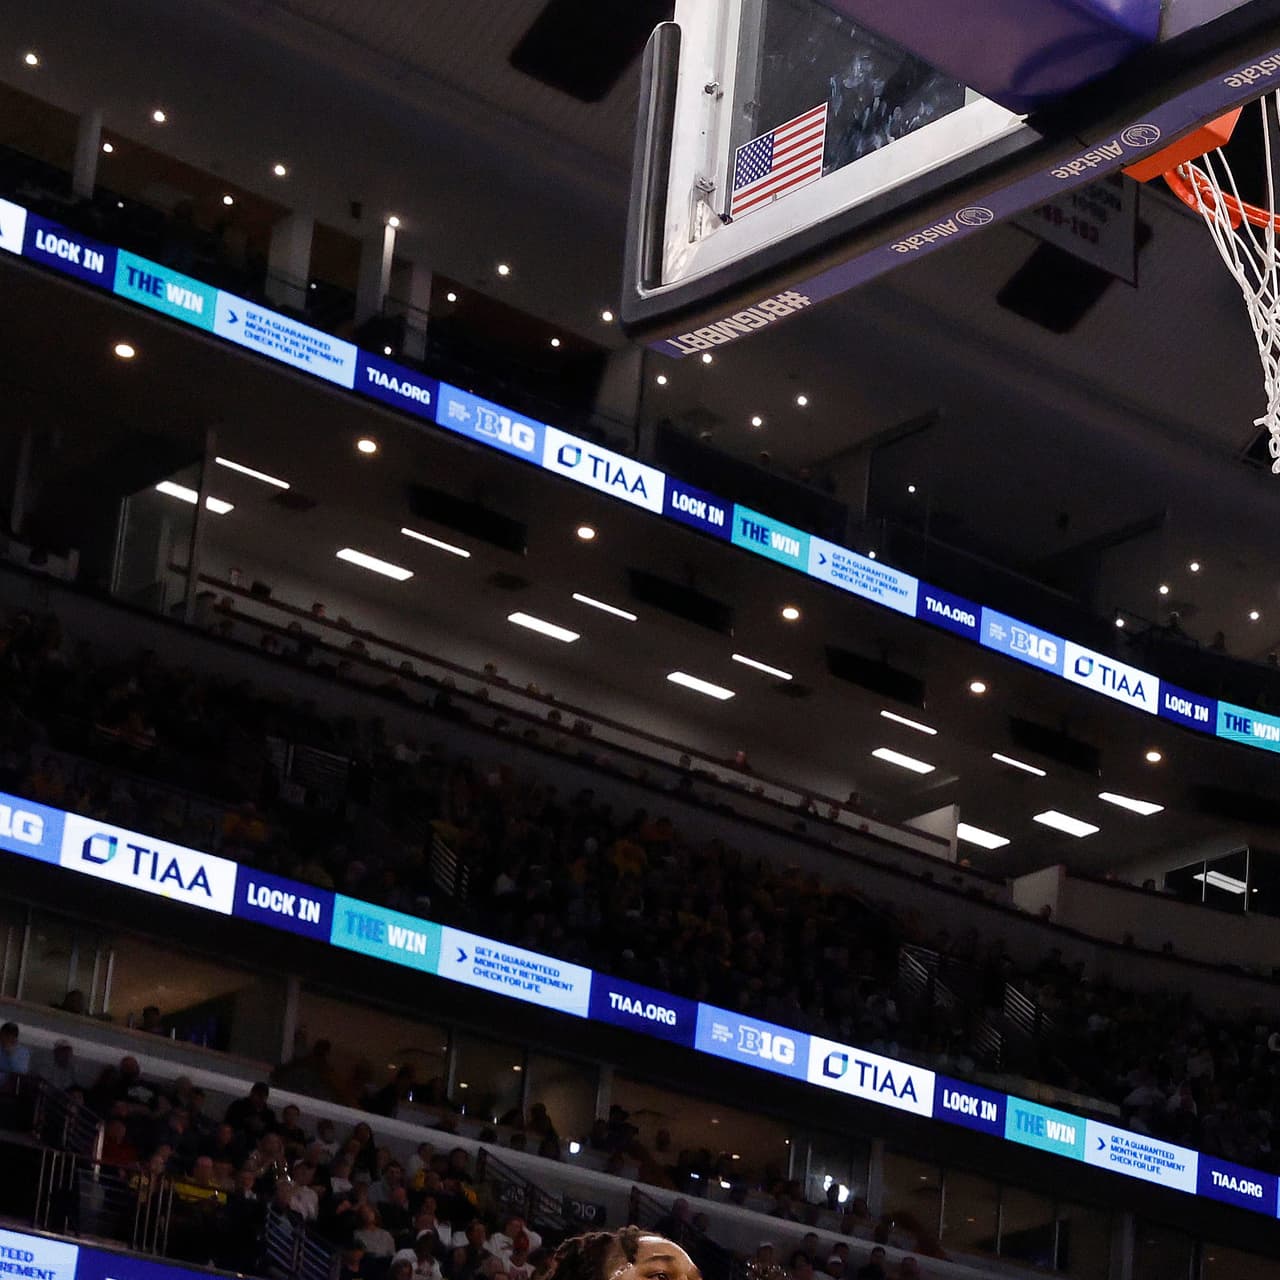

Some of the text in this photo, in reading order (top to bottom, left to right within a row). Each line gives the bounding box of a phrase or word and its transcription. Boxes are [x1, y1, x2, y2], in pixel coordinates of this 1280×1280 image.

[1051, 139, 1121, 182] Allstate
[891, 219, 959, 255] Allstate
[36, 229, 203, 314] LOCK IN THE WIN
[664, 290, 812, 354] #B1GMBBT
[367, 367, 431, 405] TIAA.ORG
[475, 407, 535, 452] B1G
[589, 453, 648, 499] TIAA
[128, 843, 212, 897] TIAA
[248, 883, 426, 955] LOCK IN THE WIN
[473, 967, 503, 982] CHECK
[504, 976, 521, 987] FOR
[475, 946, 492, 957] GET
[501, 955, 560, 977] GUARANTEED
[475, 957, 574, 992] MONTHLY RETIREMENT
[609, 992, 676, 1026] TIAA.ORG
[737, 1026, 795, 1064] B1G
[855, 1060, 918, 1103] TIAA
